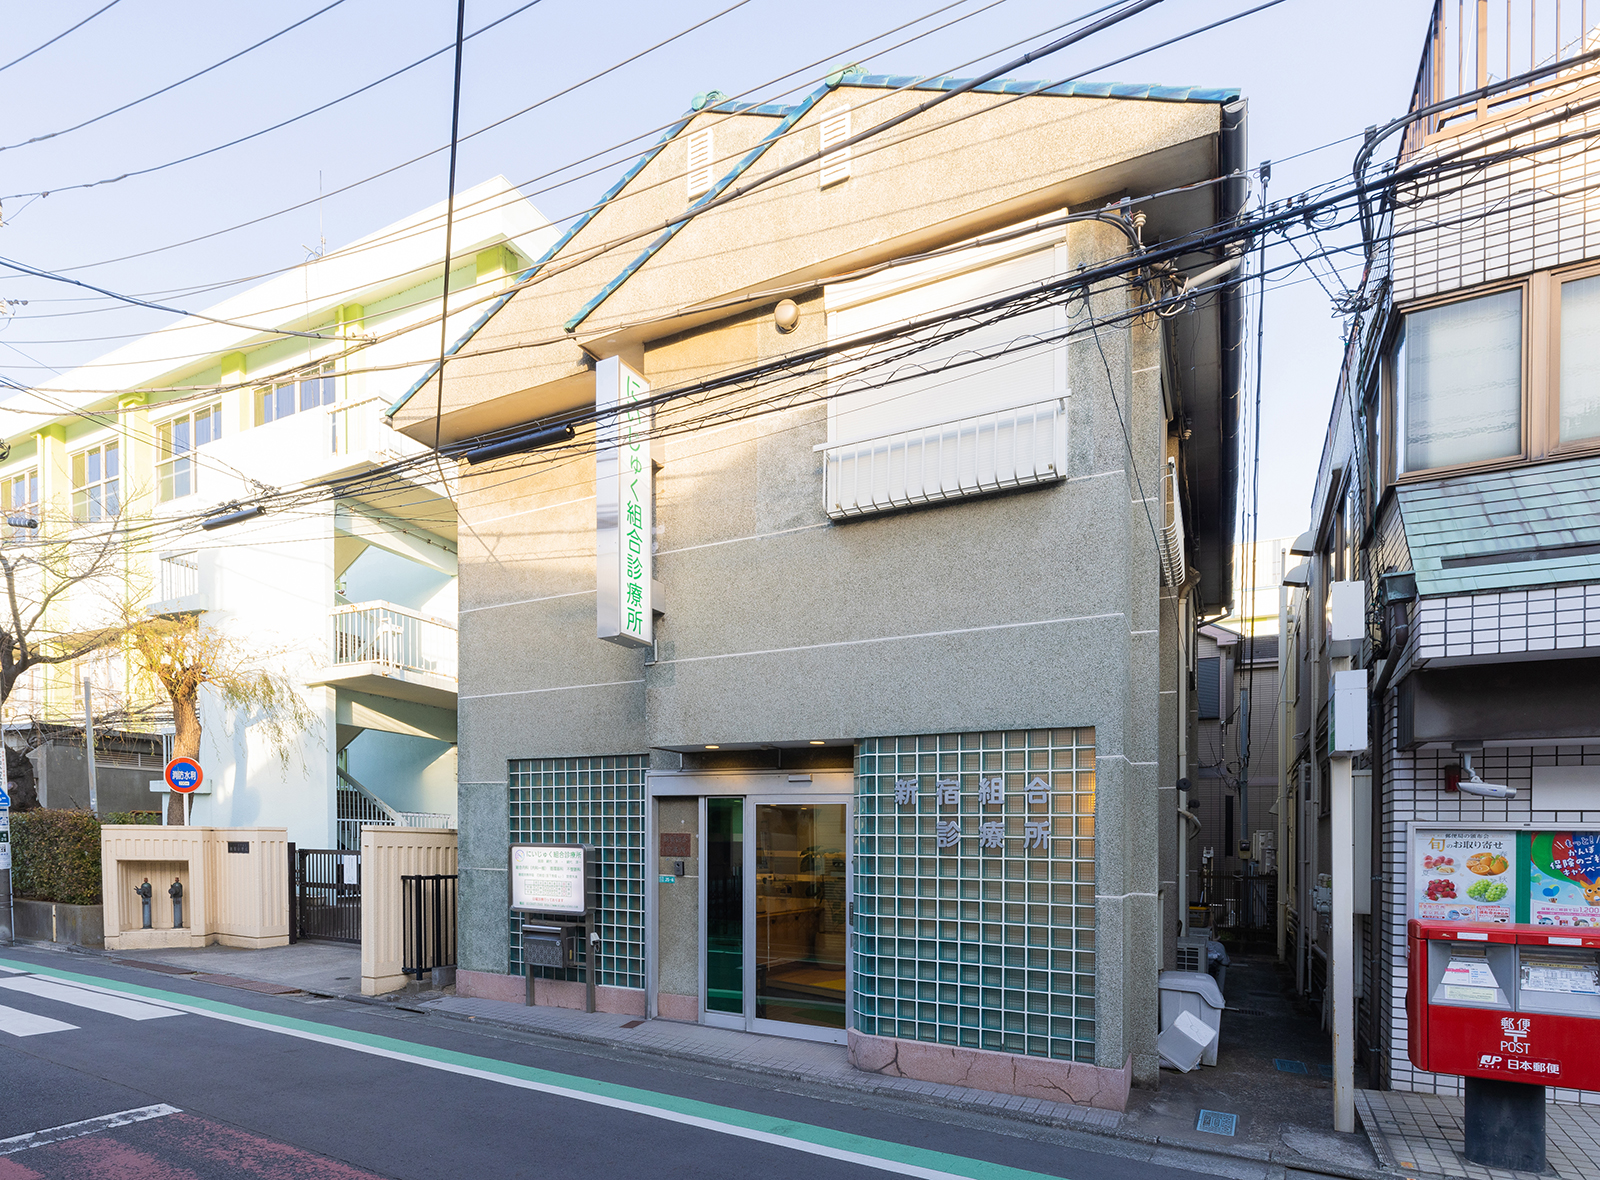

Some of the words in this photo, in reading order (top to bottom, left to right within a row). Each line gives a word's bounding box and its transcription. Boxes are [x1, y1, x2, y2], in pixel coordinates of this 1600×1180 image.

[626, 375, 643, 635] にいじゅく組合診療所
[894, 776, 1051, 806] 新宿組合
[936, 820, 1051, 850] 診療所
[1428, 837, 1503, 852] 旬のお取り寄せ
[526, 850, 582, 859] にいじゅく組合診療所
[1501, 1017, 1531, 1032] 郵便
[1500, 1040, 1531, 1055] POST
[1507, 1059, 1560, 1075] 日本郵便
